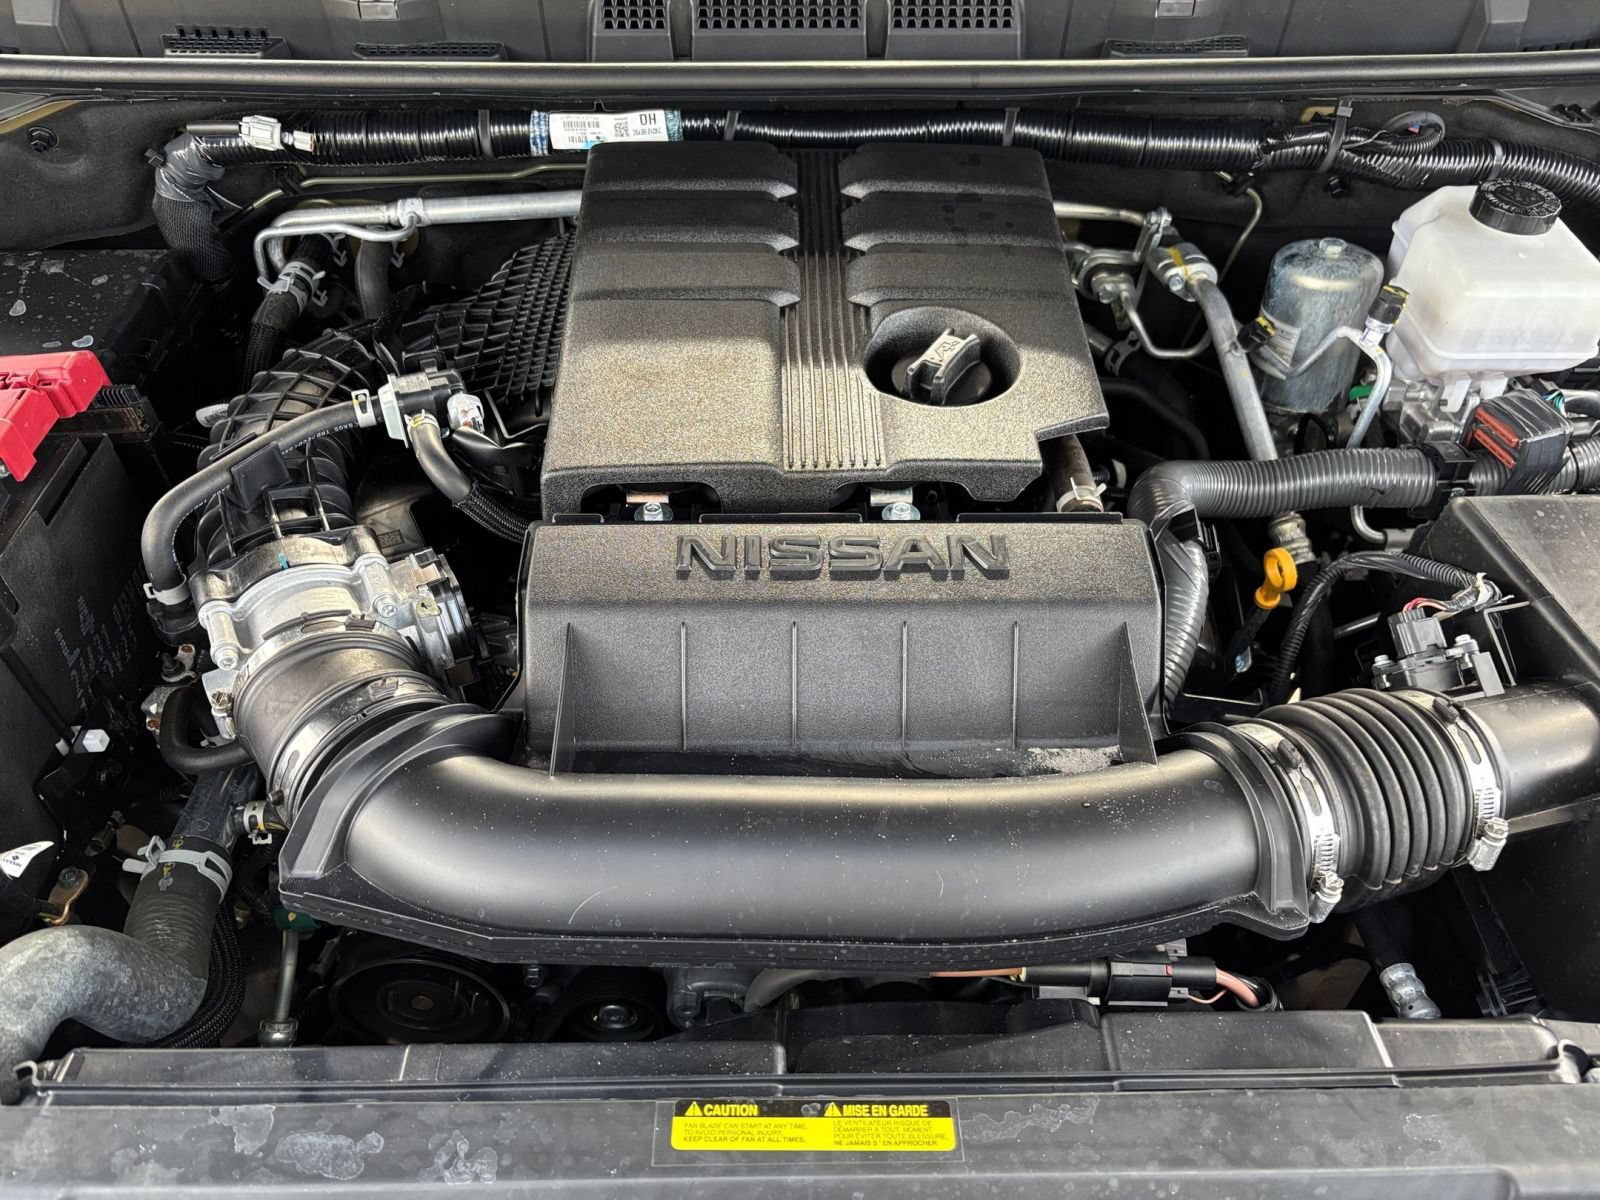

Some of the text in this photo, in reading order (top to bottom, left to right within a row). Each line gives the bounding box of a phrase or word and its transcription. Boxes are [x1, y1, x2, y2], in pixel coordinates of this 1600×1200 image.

[676, 535, 1009, 579] NISSAN
[703, 1104, 758, 1116] CAUTION
[842, 1104, 929, 1116] MISE EN GARDE
